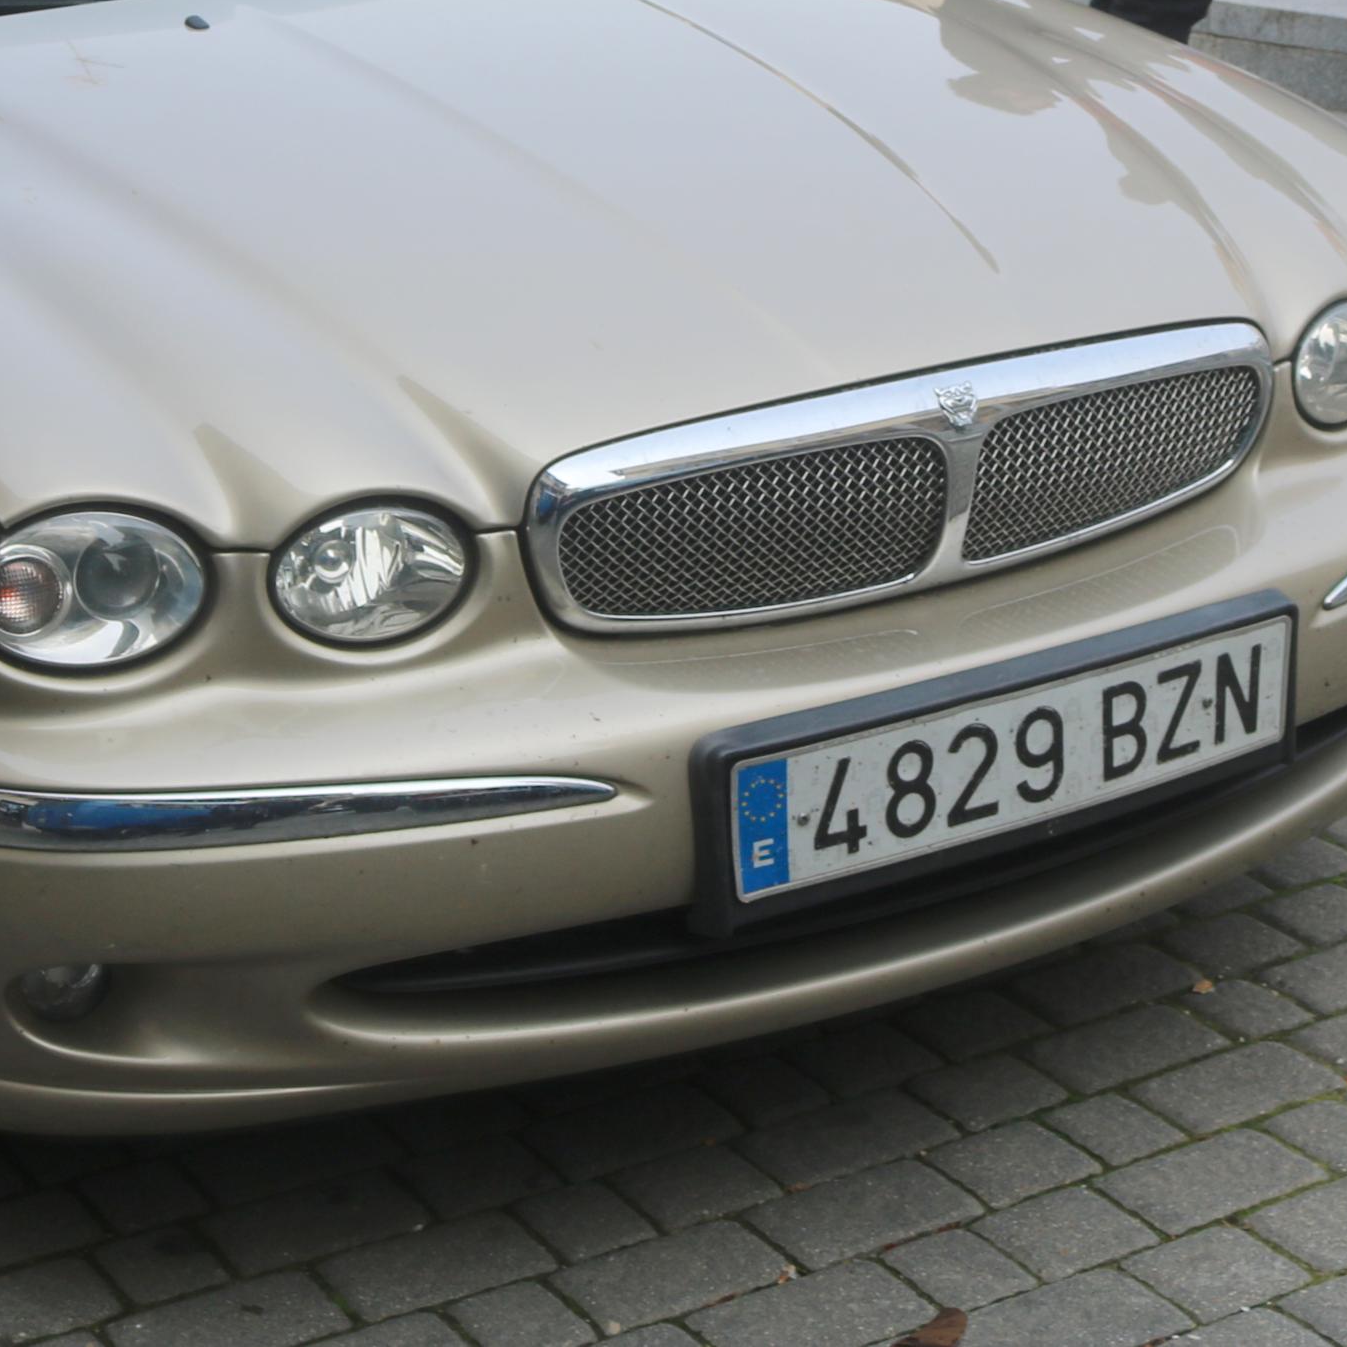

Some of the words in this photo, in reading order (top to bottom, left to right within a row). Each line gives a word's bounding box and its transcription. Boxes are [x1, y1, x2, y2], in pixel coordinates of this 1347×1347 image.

[813, 705, 1065, 855] 4829
[1101, 643, 1262, 782] BZN
[752, 837, 775, 869] E
